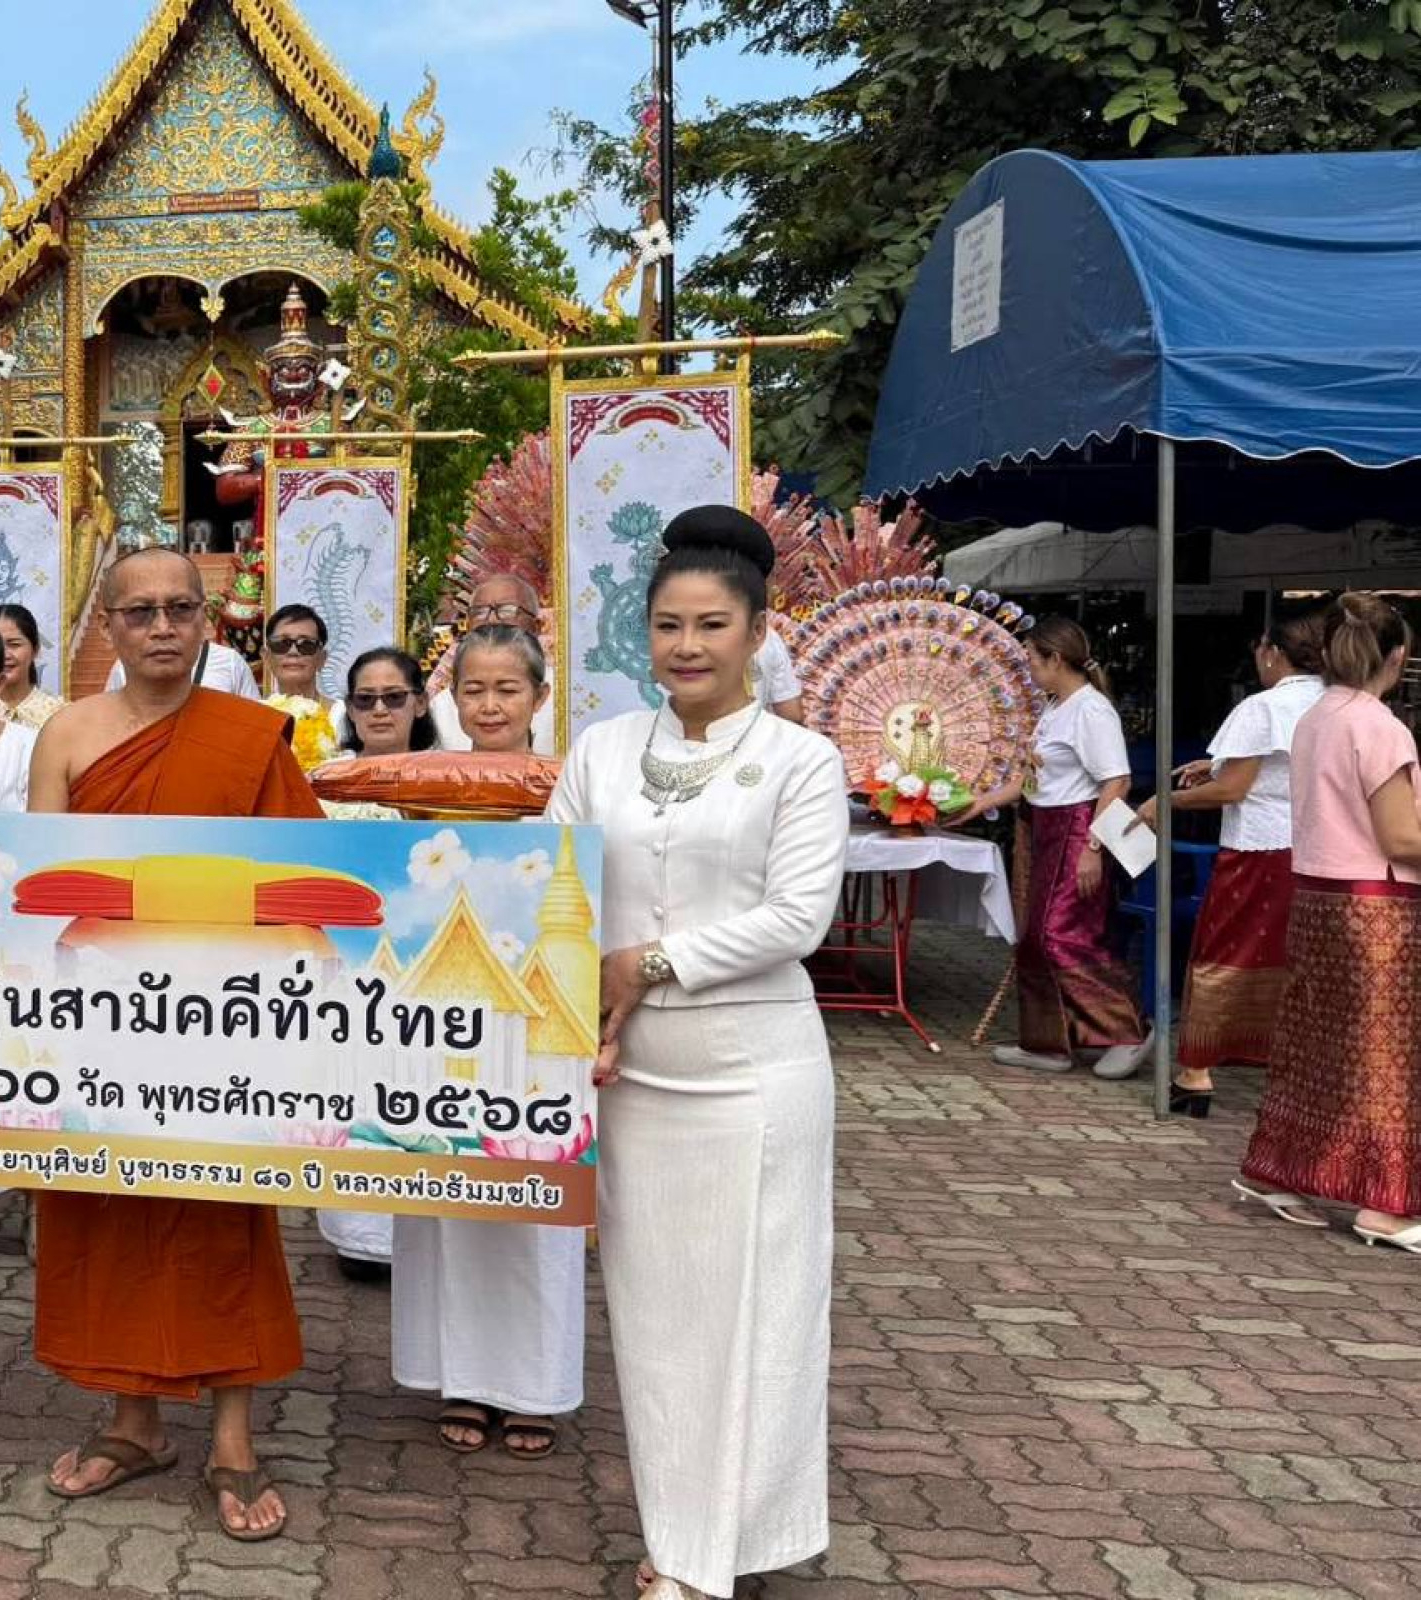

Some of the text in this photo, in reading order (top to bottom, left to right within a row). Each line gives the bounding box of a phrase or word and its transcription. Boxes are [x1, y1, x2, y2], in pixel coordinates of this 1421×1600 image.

[77, 1067, 124, 1108] วัด
[137, 1075, 355, 1126] พุทธศักราช
[374, 1082, 573, 1136] ๒๕๖๘
[118, 1158, 242, 1186] บูชาธรรม
[253, 1168, 292, 1187] ๘๑
[302, 1162, 323, 1189] ปี
[333, 1170, 561, 1206] หลวงพ่อธัมมชโย
